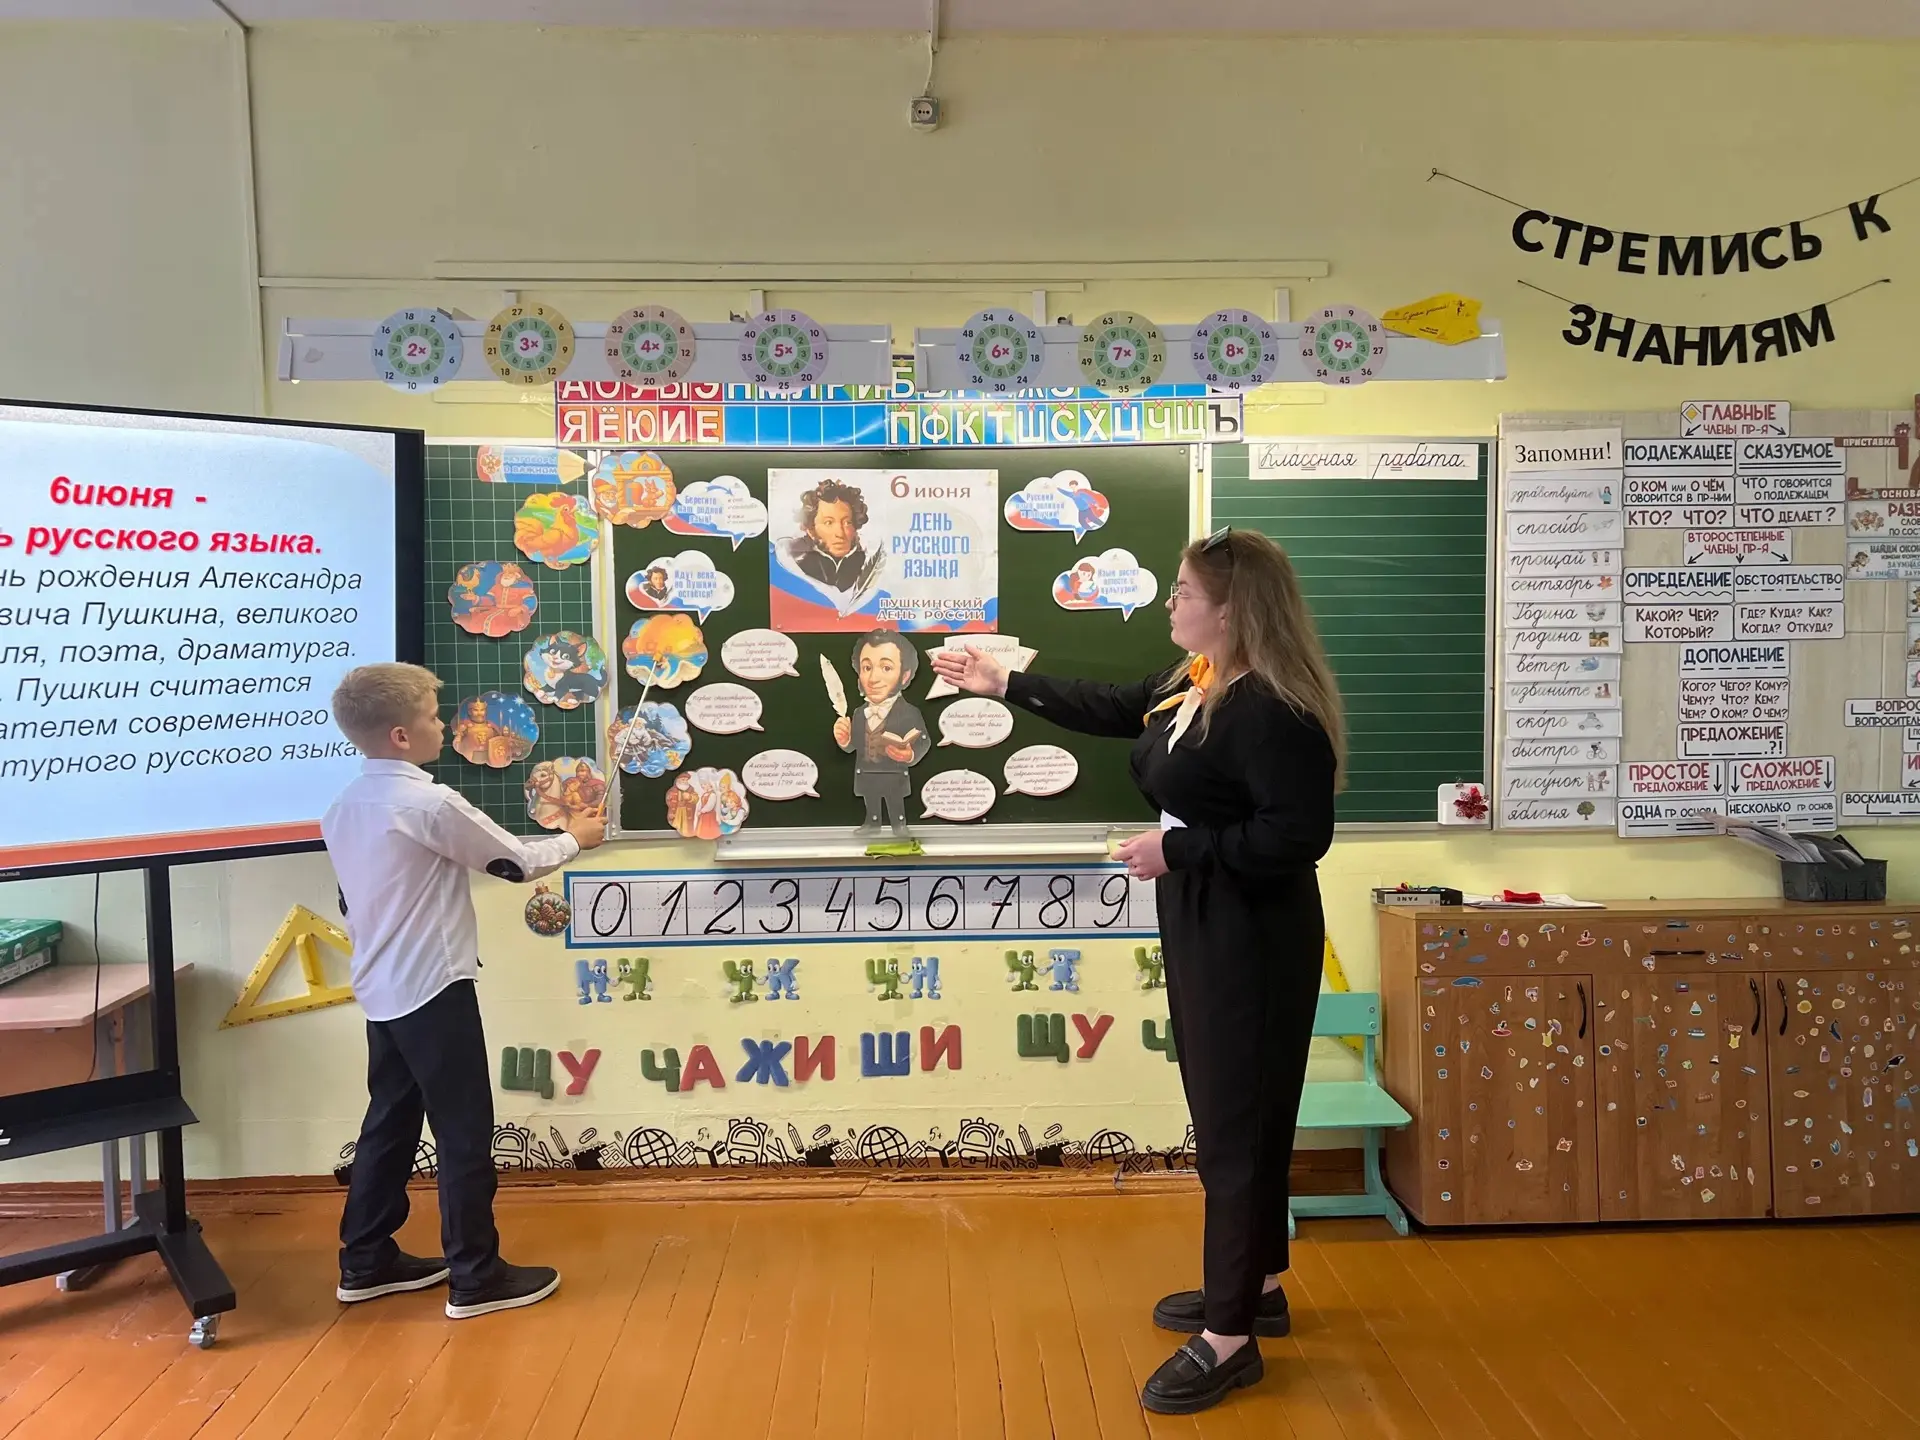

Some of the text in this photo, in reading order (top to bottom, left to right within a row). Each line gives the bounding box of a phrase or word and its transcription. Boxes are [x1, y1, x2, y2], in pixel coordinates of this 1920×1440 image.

[1511, 194, 1892, 276] СТРЕМИСЬ К
[1562, 303, 1835, 366] ЗНАНИЯМ
[1701, 404, 1777, 421] ГЛАВНЫЕ
[1703, 424, 1769, 435] ЧЛЕНЫ ПР-Я
[1515, 441, 1612, 463] Запомни!
[1743, 443, 1834, 460] СКАЗУЕМОЕ
[1843, 437, 1896, 447] ПРИСТАВКА
[1624, 445, 1733, 462] ПОДЛЕЖАЩЕЕ
[49, 476, 174, 508] 6июня
[890, 475, 971, 499] 6 июня
[1629, 481, 1639, 492] О
[1641, 480, 1668, 492] КОМ
[1690, 481, 1700, 492] О
[1702, 478, 1725, 492] ЧЁМ
[1742, 477, 1832, 489] ЧТО ГОВОРИТСЯ
[1625, 492, 1732, 503] ГОВОРИТСЯ В ПР-НИИ
[1764, 490, 1829, 501] ПОДЛЕЖАЩЕМ
[909, 512, 953, 533] ДЕНЬ
[1628, 510, 1727, 526] КТО? ЧТО?
[1740, 508, 1775, 524] ЧТО
[1778, 510, 1822, 524] ДЕЛАЕТ
[25, 525, 323, 556] русского языка.
[892, 535, 970, 557] РУССКОГО
[1688, 530, 1785, 543] ВТОРОСТЕПЕННЫЕ
[1704, 543, 1769, 554] ЧЛЕНЫ ПР-Я
[36, 564, 363, 595] рождения Александра
[904, 559, 959, 580] ЯЗЫКА
[1735, 573, 1843, 586] ОБСТОЯТЕЛЬСТВО
[1625, 572, 1732, 589] ОПРЕДЕЛЕНИЕ
[880, 597, 983, 609] ПУШКИНСКИЙ
[82, 601, 224, 631] Пушкина,
[236, 606, 359, 626] великого
[877, 609, 985, 622] ДЕНЬ РОССИИ
[60, 643, 166, 665] поэта,
[177, 638, 357, 666] драматурга.
[1683, 647, 1784, 665] ДОПОЛНЕНИЕ
[15, 675, 311, 707] Пушкин считается
[128, 708, 329, 737] современного
[1680, 726, 1784, 742] ПРЕДЛОЖЕНИЕ
[145, 745, 272, 775] русского
[1740, 759, 1824, 779] СЛОЖНОЕ
[1628, 762, 1710, 781] ПРОСТОЕ
[1633, 780, 1709, 793] ПРЕДЛОЖЕНИЕ
[1746, 778, 1821, 792] ПРЕДЛОЖЕНИЕ
[1622, 805, 1662, 820] ОДНА
[1729, 802, 1834, 814] НЕСКОЛЬКО ОСНОВ
[591, 882, 628, 937] 0
[661, 881, 688, 936] 1
[703, 880, 743, 935] 2
[758, 879, 799, 933] 3
[825, 877, 853, 932] 4
[868, 877, 910, 932] 5
[926, 875, 964, 931] 6
[984, 875, 1020, 929] 7
[1038, 874, 1075, 929] 8
[1093, 874, 1130, 928] 9
